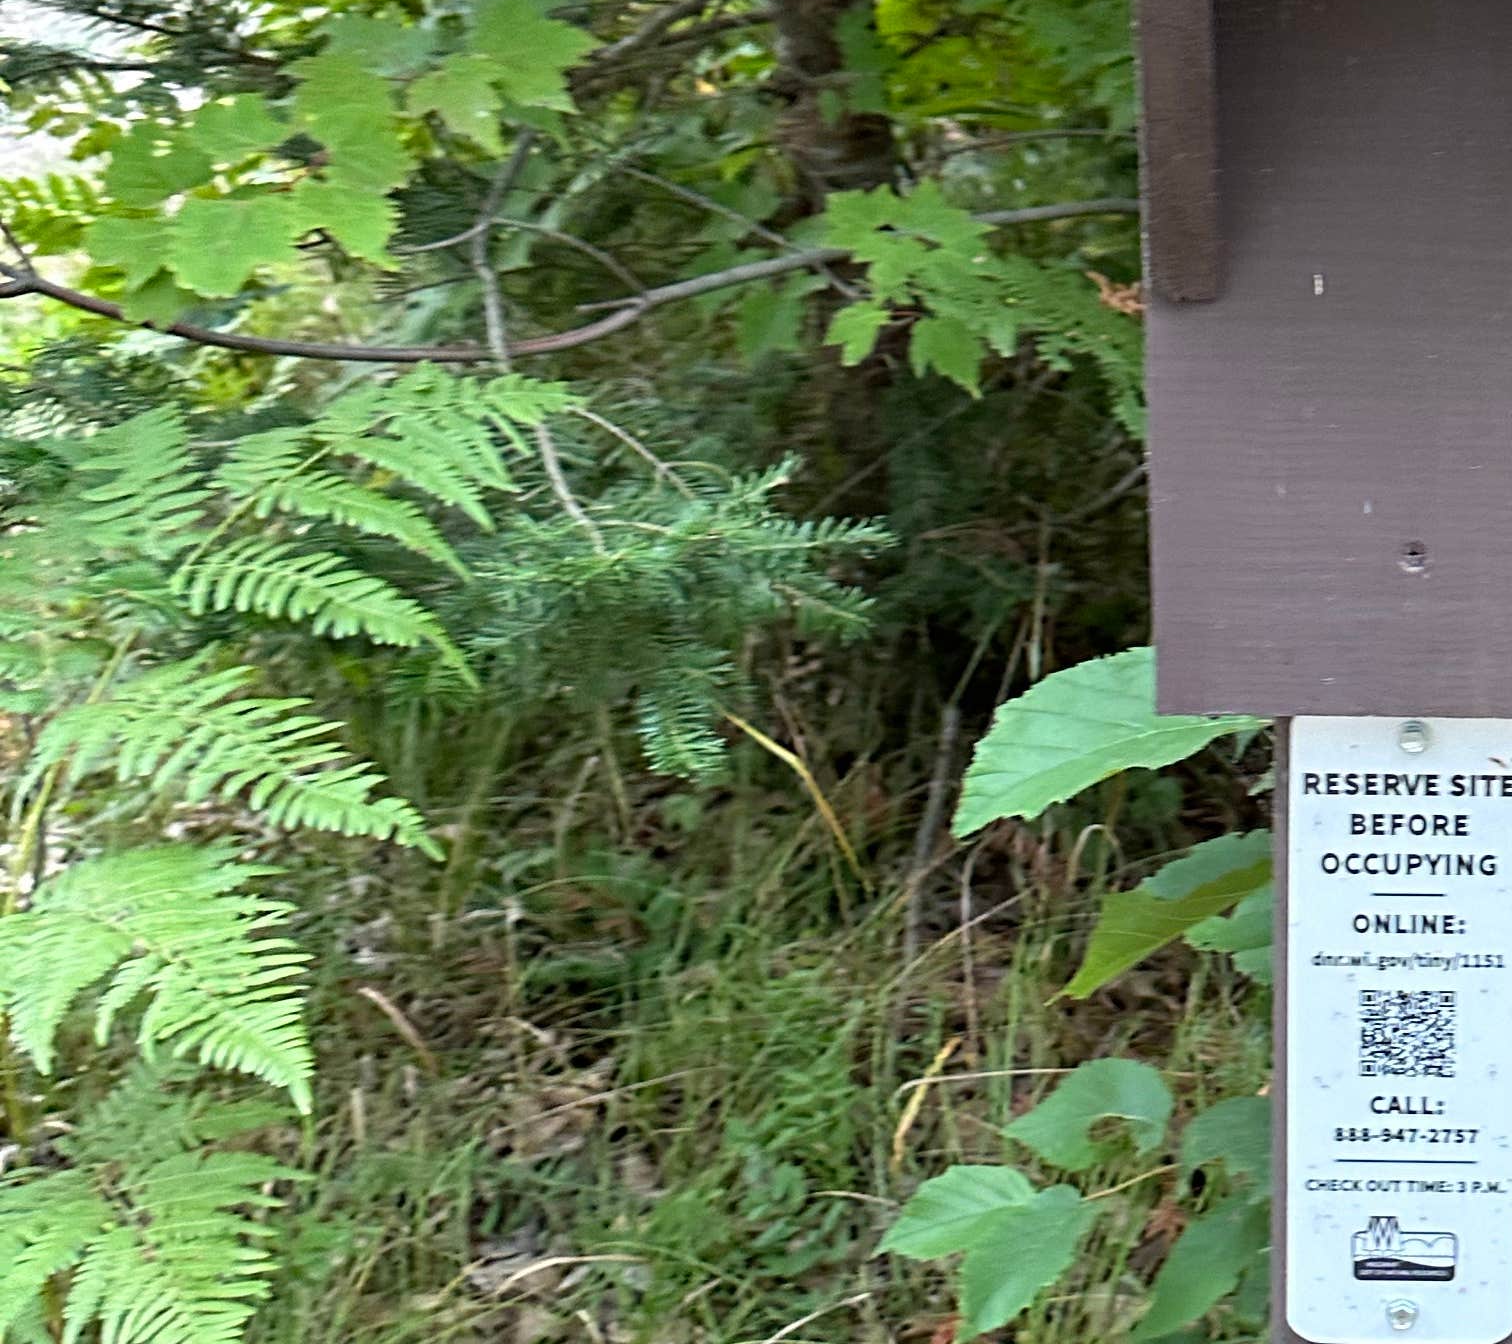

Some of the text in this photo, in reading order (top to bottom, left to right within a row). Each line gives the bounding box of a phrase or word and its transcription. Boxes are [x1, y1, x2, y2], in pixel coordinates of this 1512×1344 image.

[1303, 773, 1441, 796] RESERVE
[1349, 813, 1471, 837] BEFORE
[1320, 853, 1499, 876] OCCUPYING
[1352, 914, 1467, 935] ONLINE:
[1369, 1096, 1447, 1116] CALL:
[1334, 1127, 1480, 1144] 888-947-2757
[1305, 1179, 1508, 1194] CHECK OUT TIME: 3 P.M.
